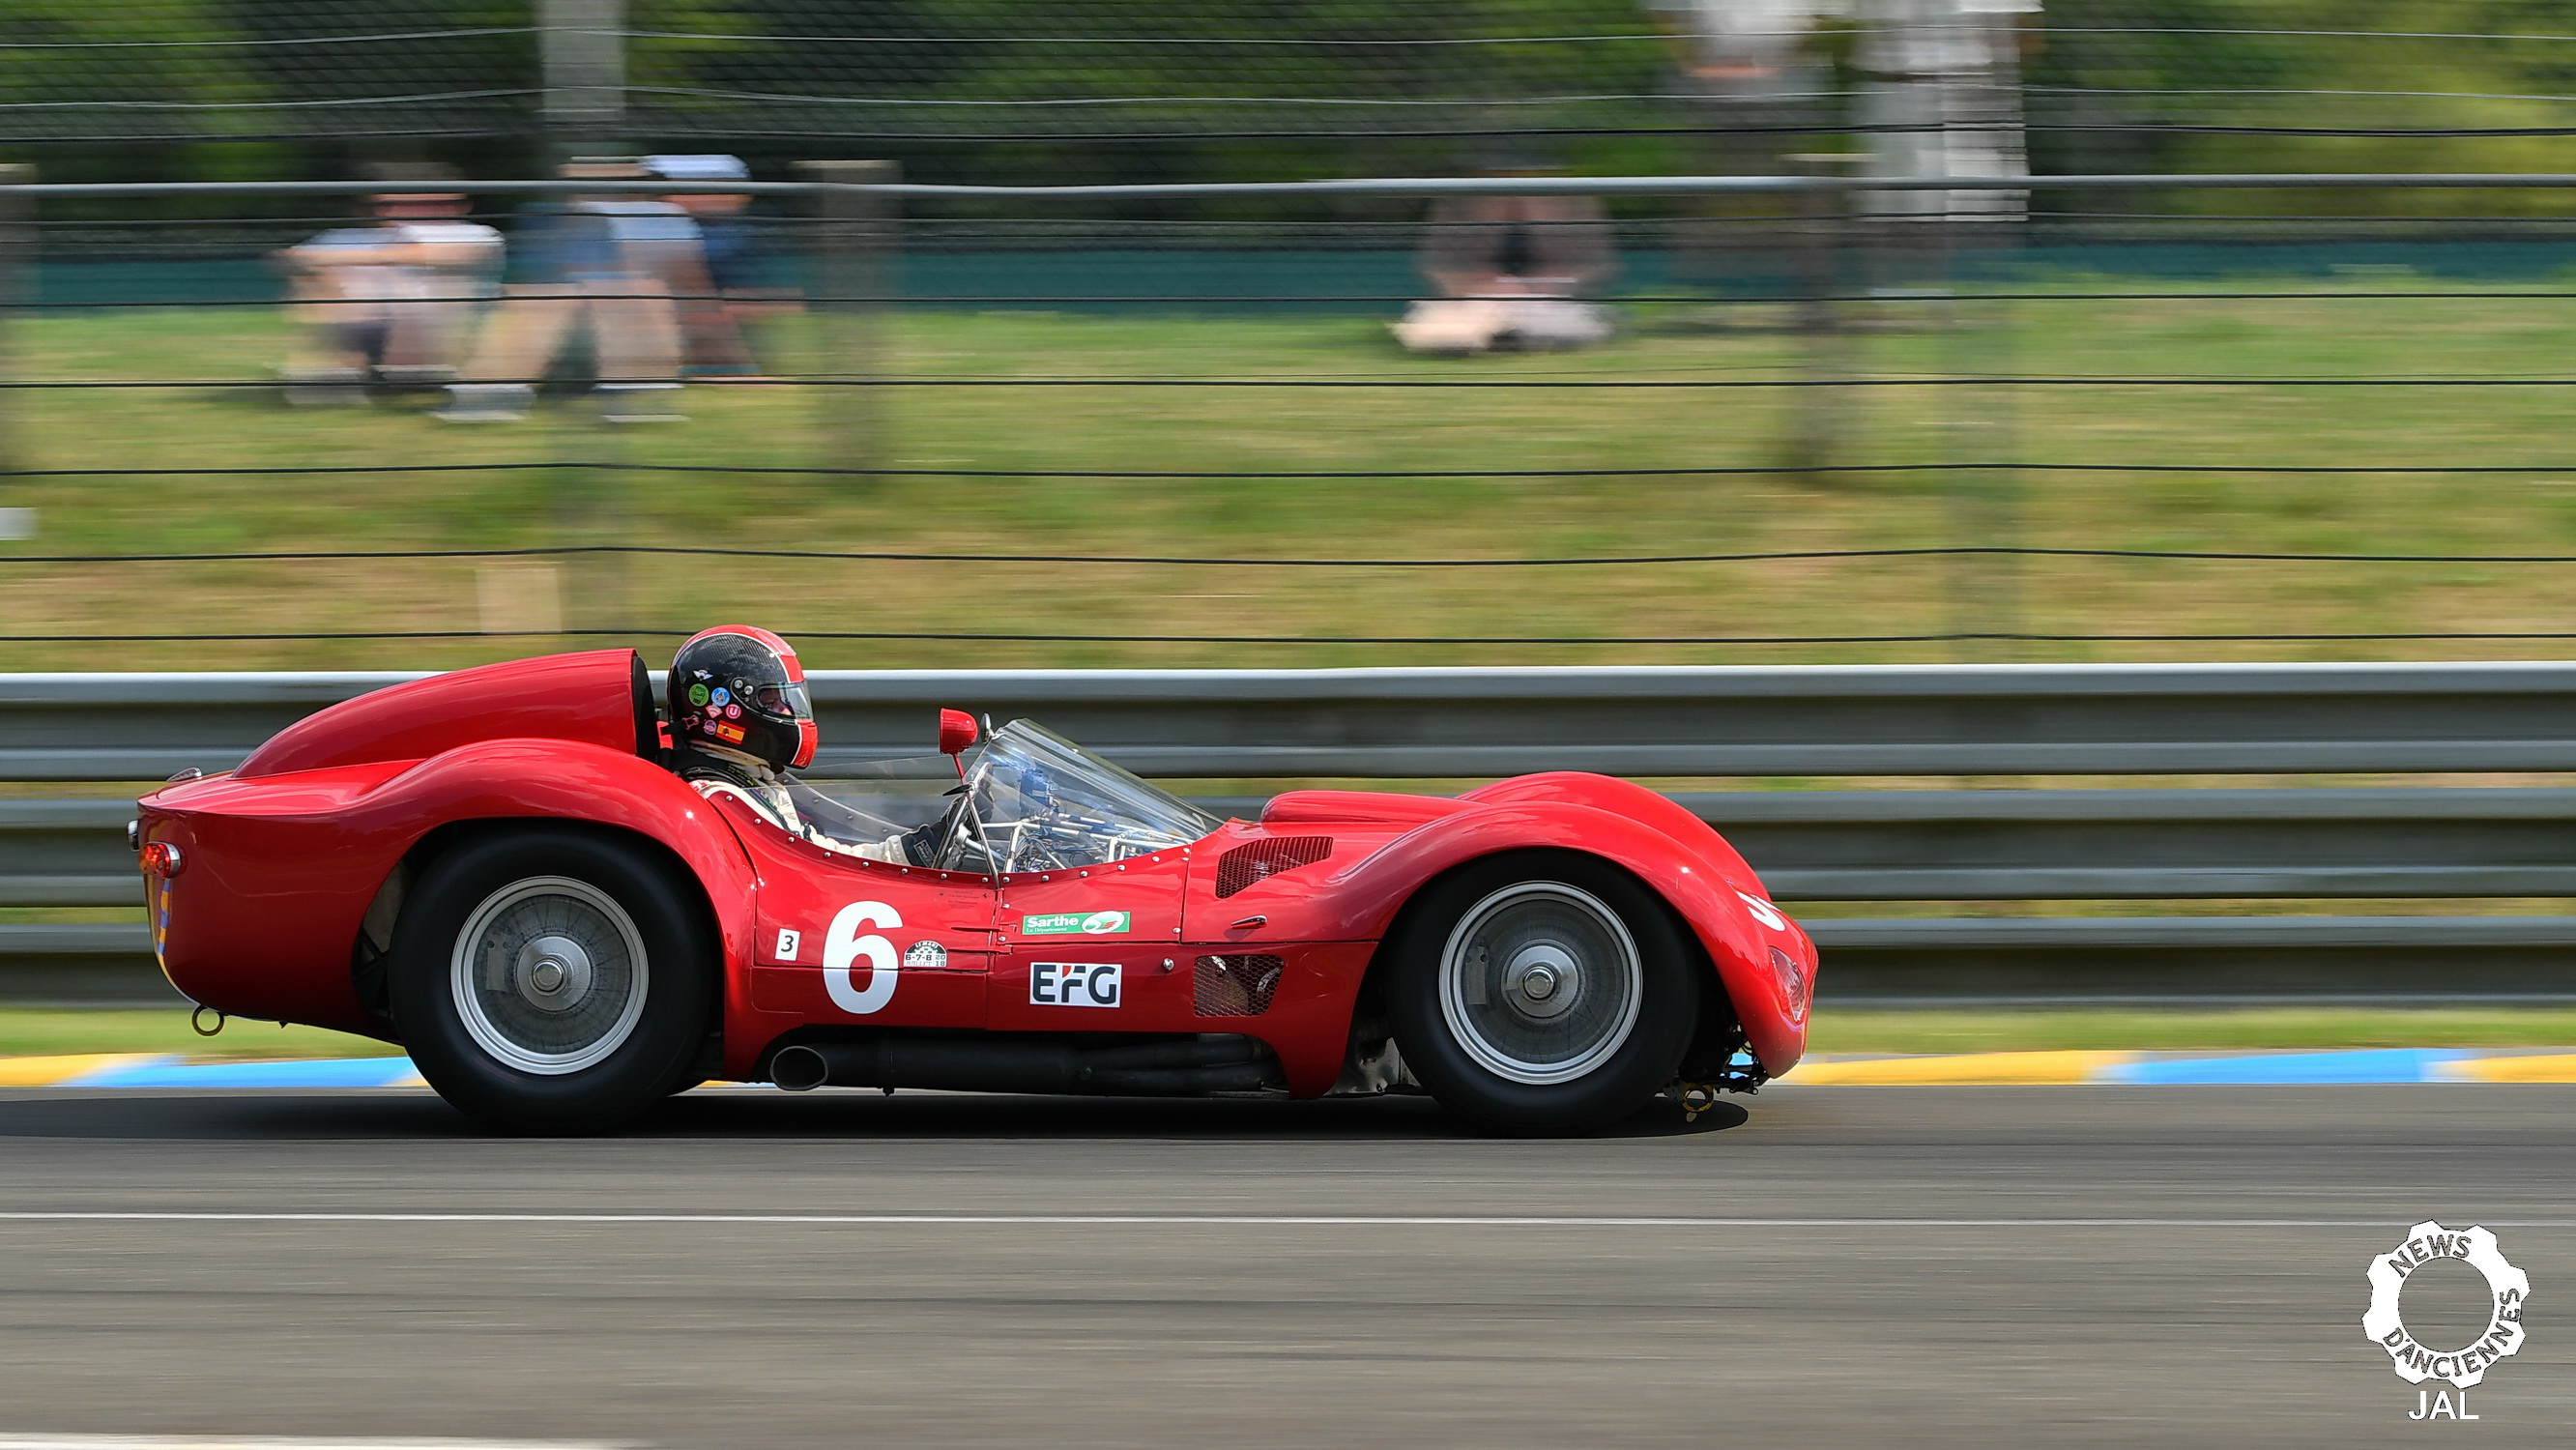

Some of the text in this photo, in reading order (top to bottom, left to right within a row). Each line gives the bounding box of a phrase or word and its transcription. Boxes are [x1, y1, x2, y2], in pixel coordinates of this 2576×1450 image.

[1027, 915, 1080, 928] Sarthe
[781, 935, 794, 952] 3
[823, 900, 904, 1014] 6
[1032, 965, 1117, 1004] EFG
